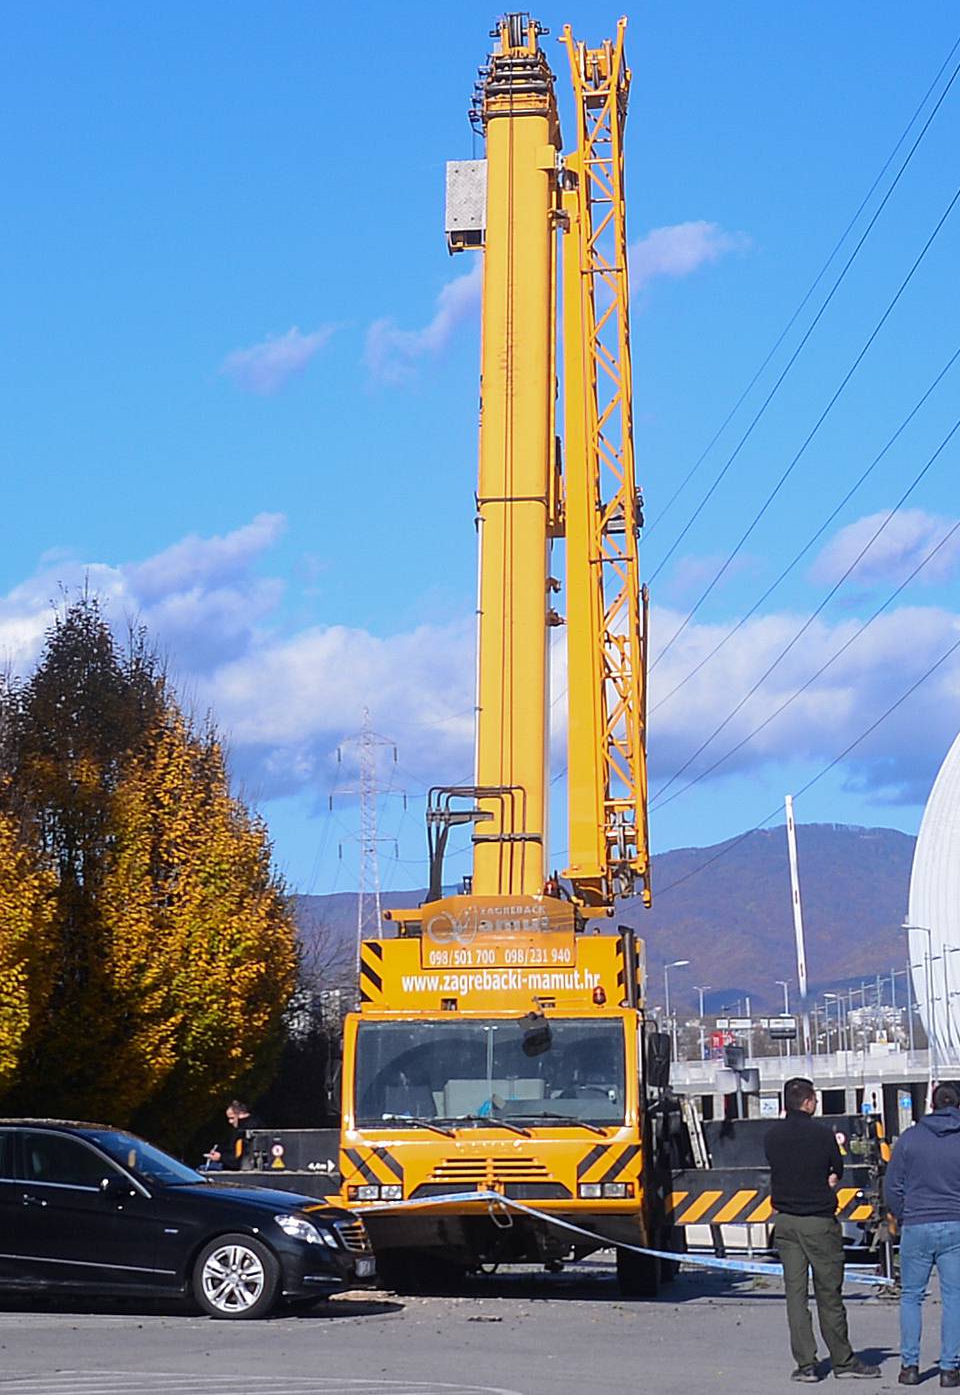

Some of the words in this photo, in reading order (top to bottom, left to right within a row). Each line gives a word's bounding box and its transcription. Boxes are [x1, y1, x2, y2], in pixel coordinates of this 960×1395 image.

[429, 949, 472, 966] 098/501
[476, 949, 495, 964] 700
[504, 948, 548, 965] 098/231
[551, 947, 571, 963] 940
[401, 968, 601, 995] www.zagrebacki-mamut.hr
